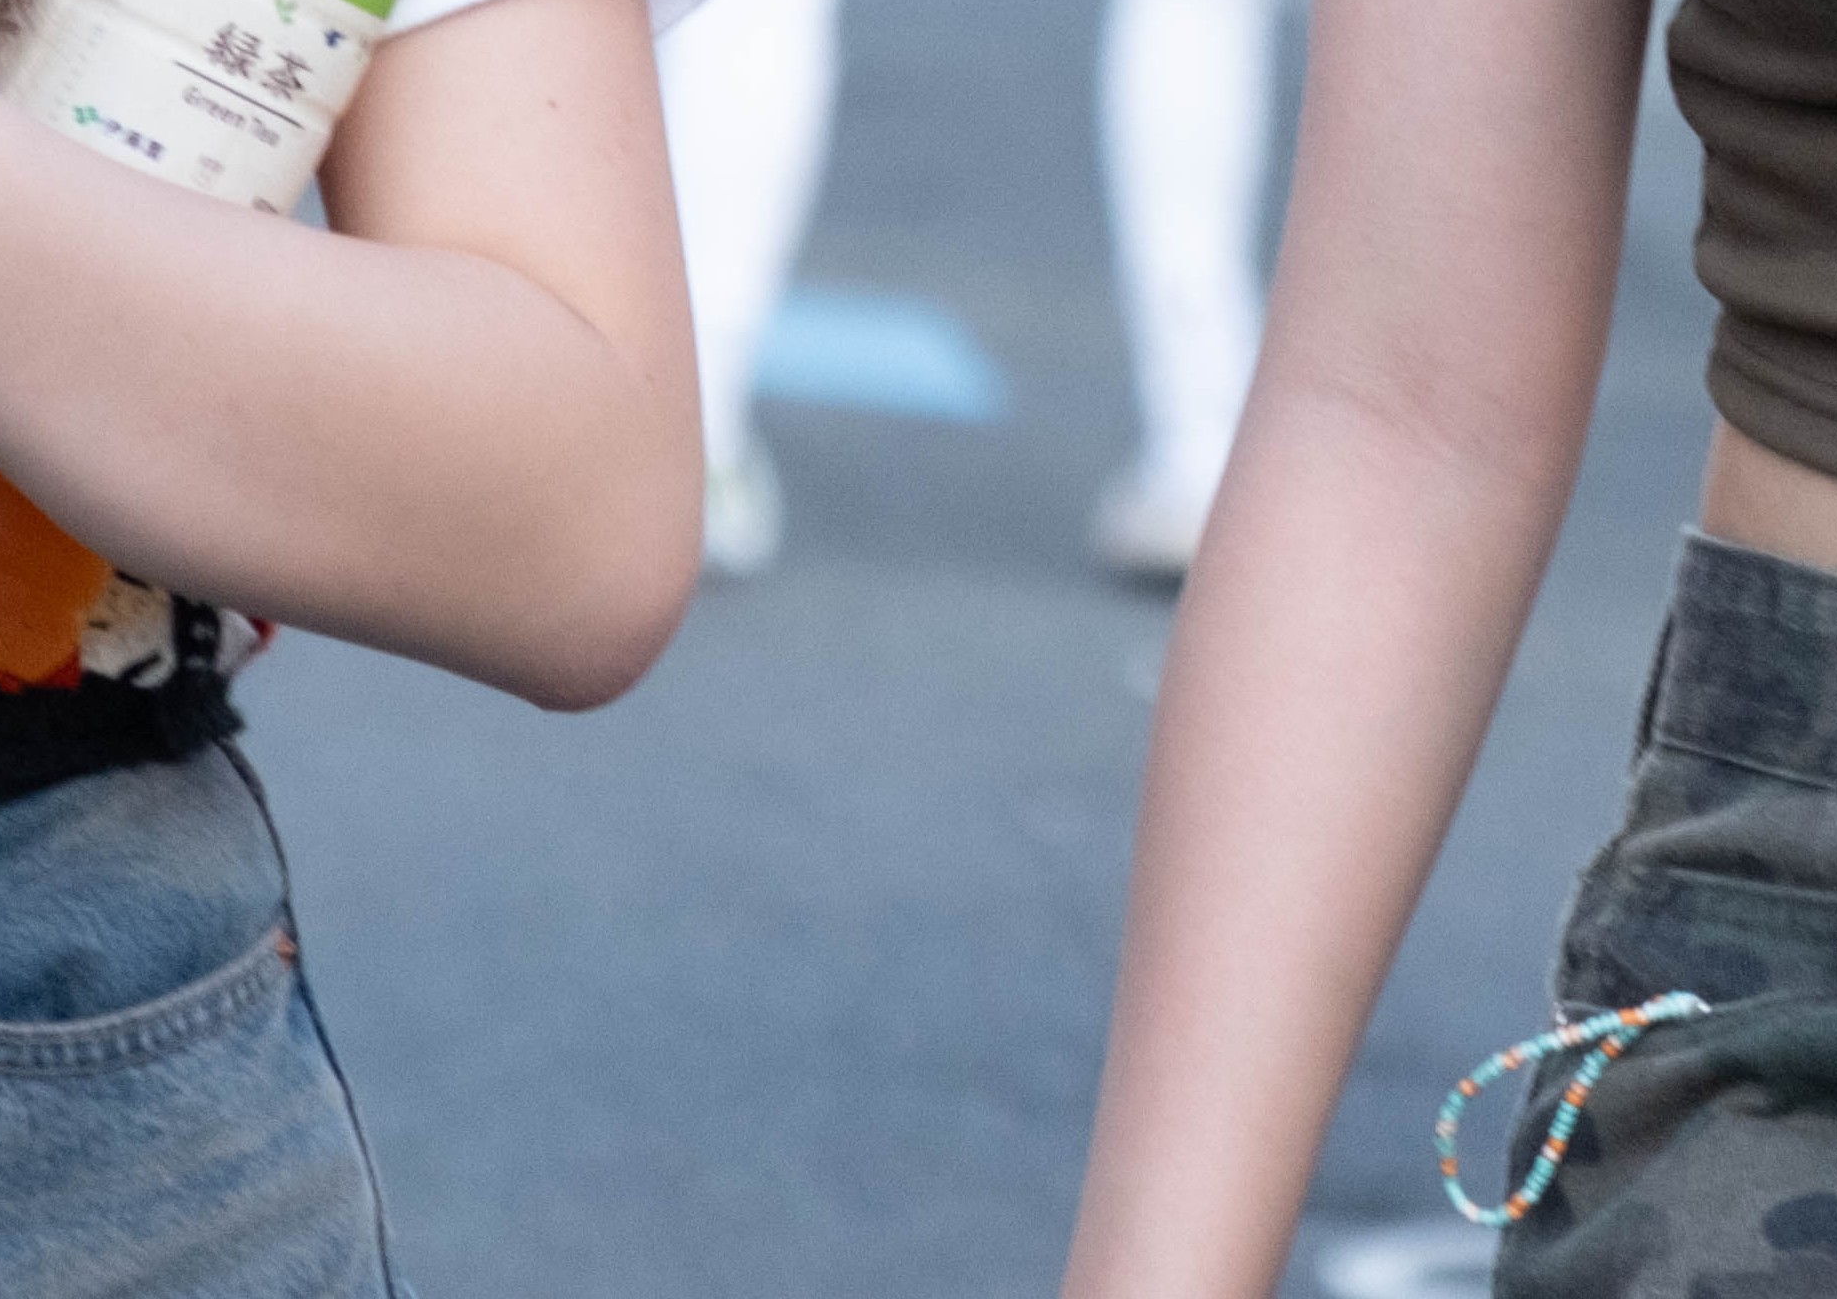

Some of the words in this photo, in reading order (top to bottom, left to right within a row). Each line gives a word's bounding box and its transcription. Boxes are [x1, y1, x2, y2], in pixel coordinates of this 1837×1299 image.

[202, 21, 314, 102] 緑茶
[181, 83, 247, 130] Green
[250, 114, 281, 148] Tea
